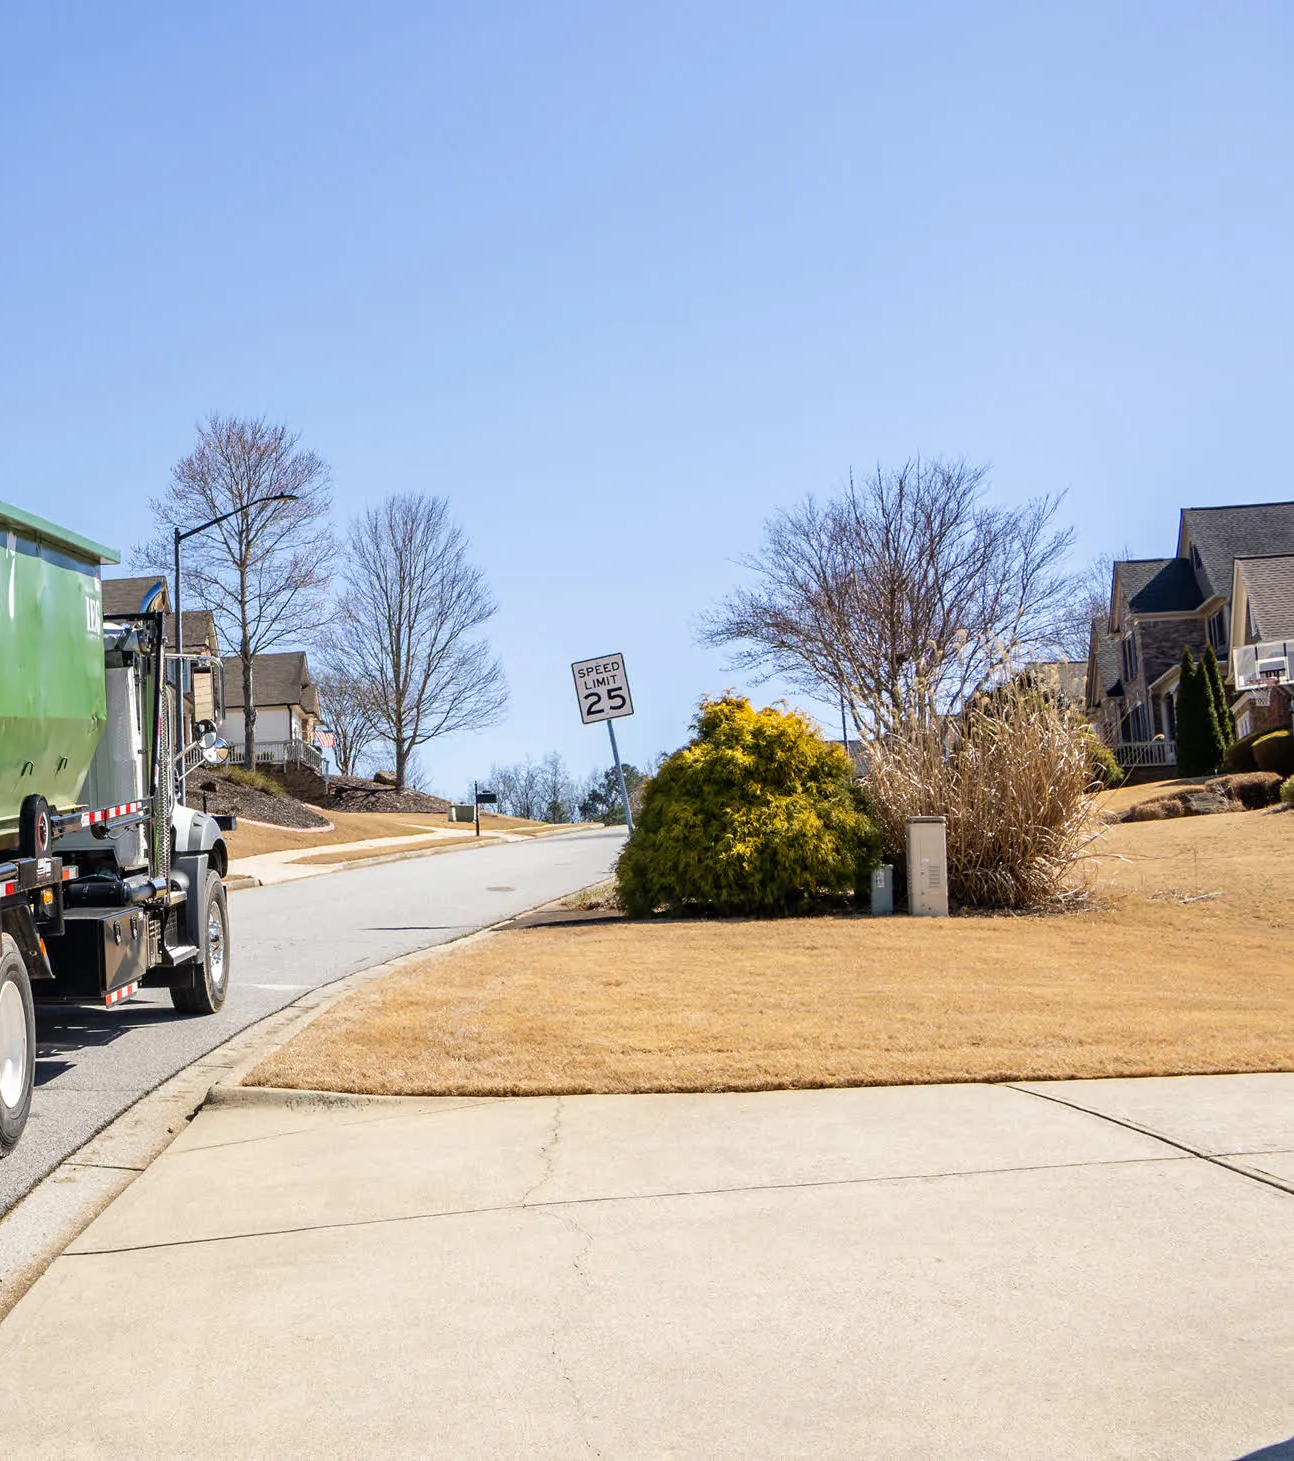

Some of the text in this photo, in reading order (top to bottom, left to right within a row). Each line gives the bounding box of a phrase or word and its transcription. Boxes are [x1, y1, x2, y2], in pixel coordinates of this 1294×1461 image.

[577, 661, 620, 679] SPEED
[584, 674, 617, 690] LIMIT
[583, 686, 626, 716] 25
